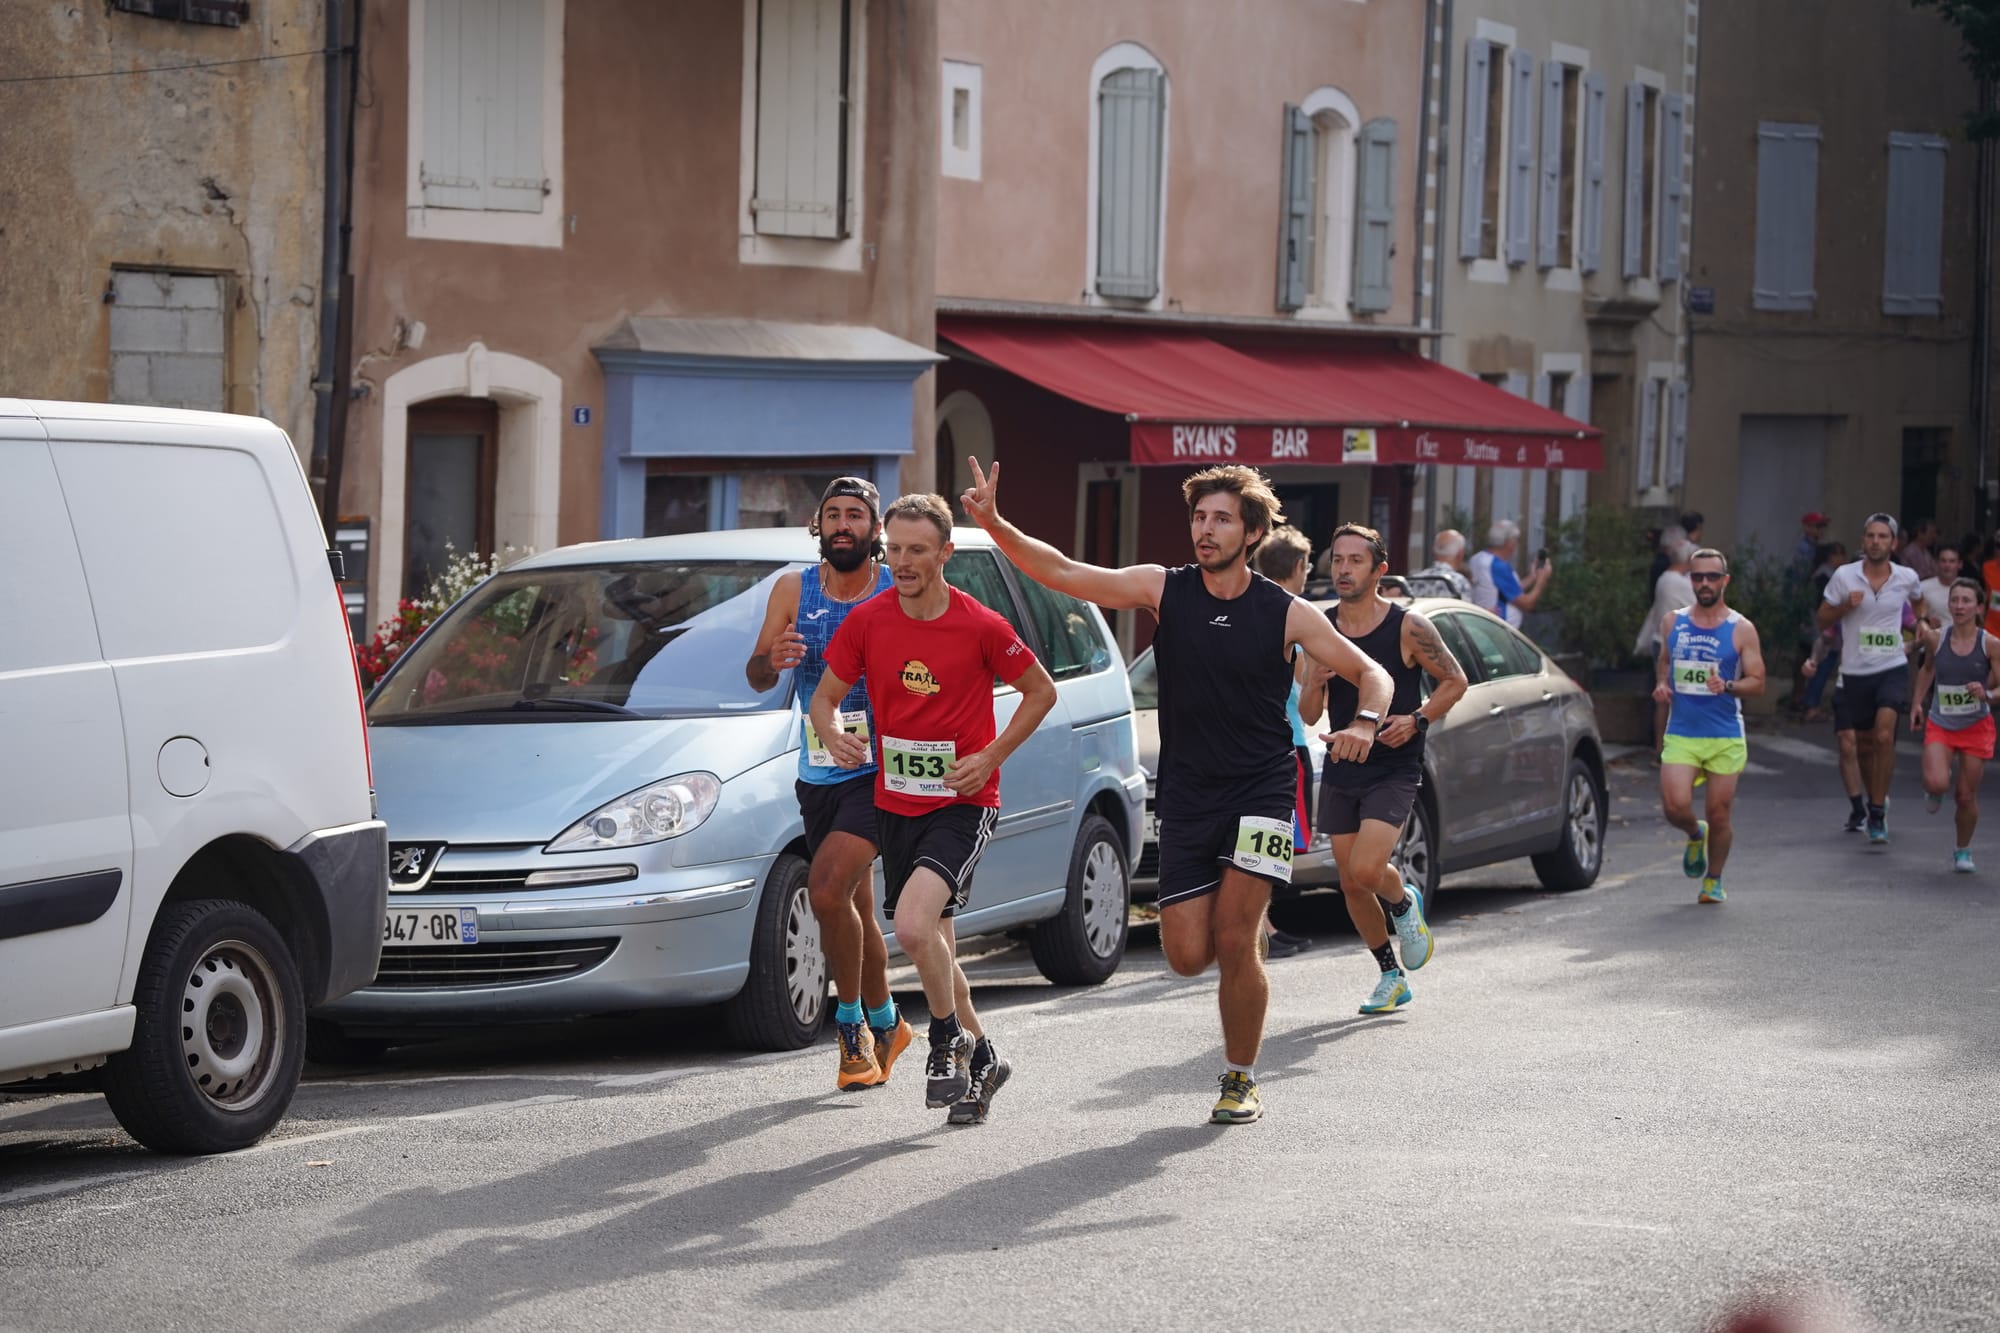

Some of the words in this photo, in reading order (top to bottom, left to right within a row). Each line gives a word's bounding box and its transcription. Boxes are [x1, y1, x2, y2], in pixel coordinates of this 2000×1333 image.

[578, 409, 586, 423] 6
[1172, 425, 1237, 457] RYAN'S
[1271, 428, 1309, 458] BAR
[1415, 432, 1440, 458] Chez
[1865, 633, 1893, 647] 105
[1683, 669, 1706, 684] 46
[1944, 692, 1975, 706] 192
[892, 753, 946, 778] 153
[1250, 830, 1292, 862] 185
[463, 926, 476, 938] 59
